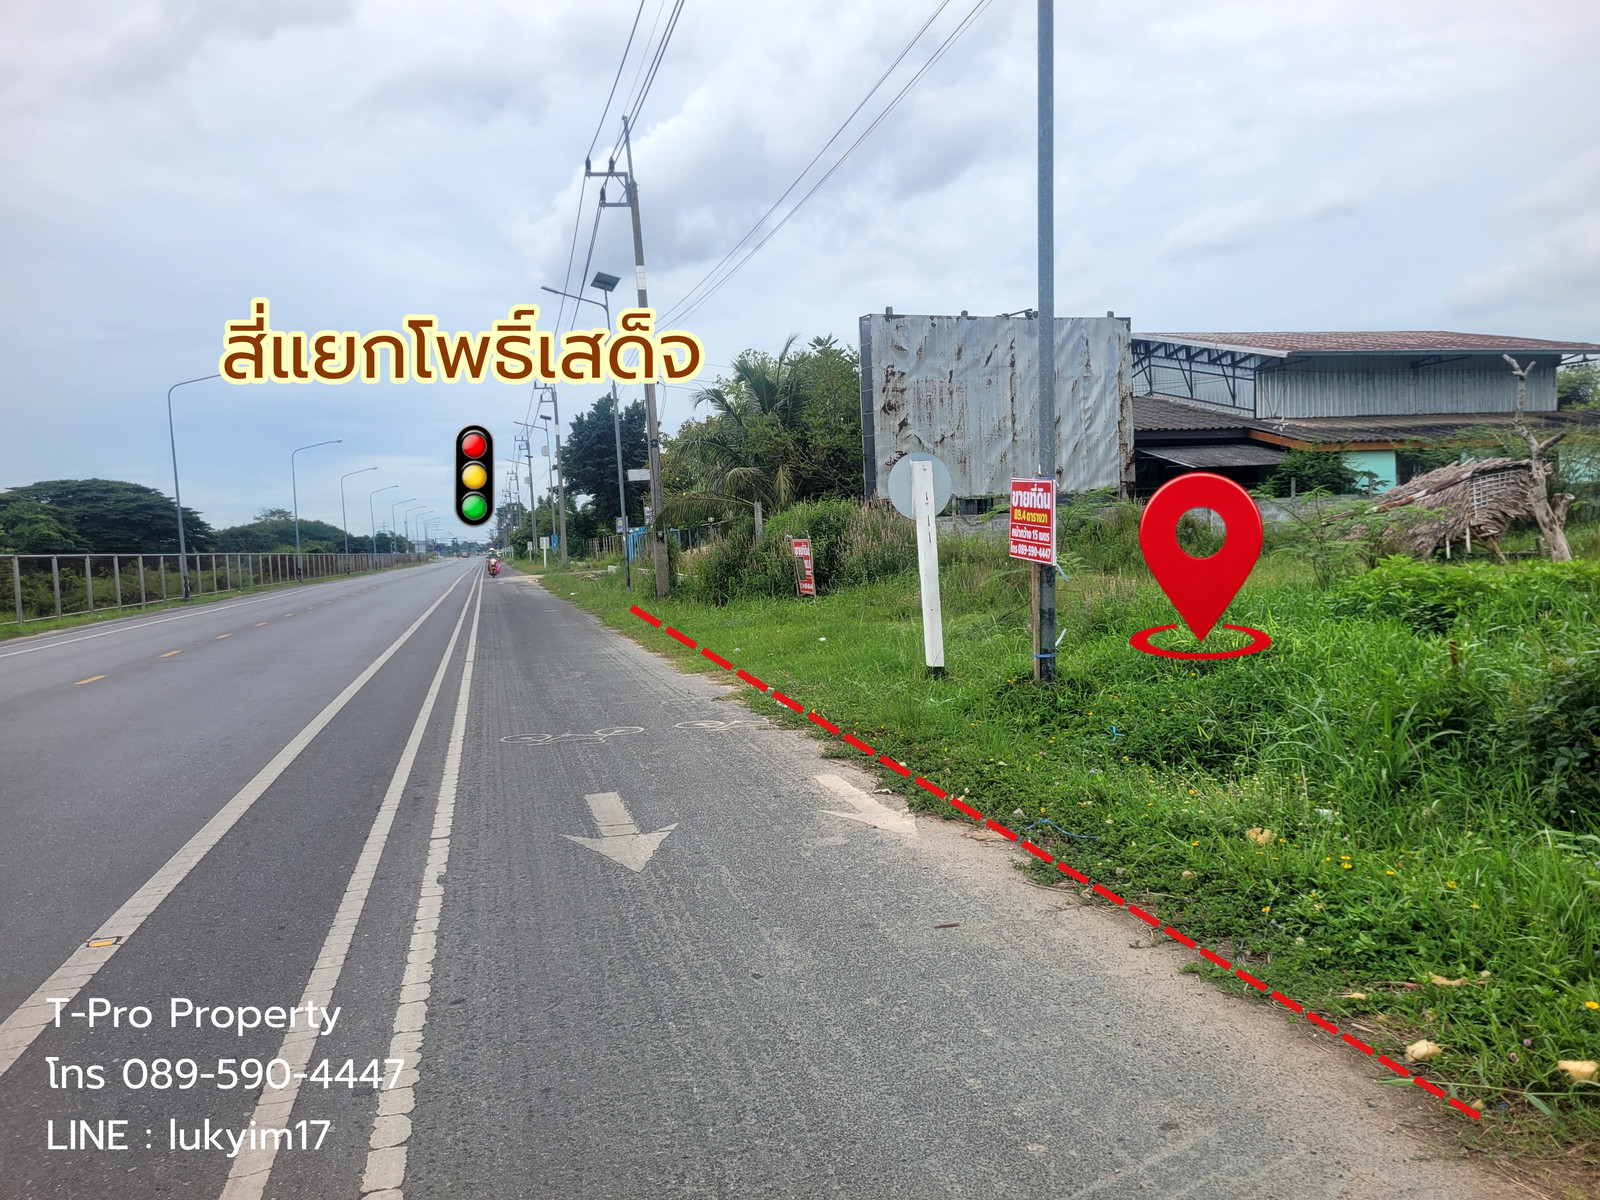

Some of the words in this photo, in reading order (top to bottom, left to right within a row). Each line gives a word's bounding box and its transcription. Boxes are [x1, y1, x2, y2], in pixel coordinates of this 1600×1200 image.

[1012, 484, 1050, 509] ขายที่ดิน
[1014, 509, 1026, 520] 89.4
[1032, 530, 1038, 540] 15
[1018, 544, 1051, 559] 089-590-4447
